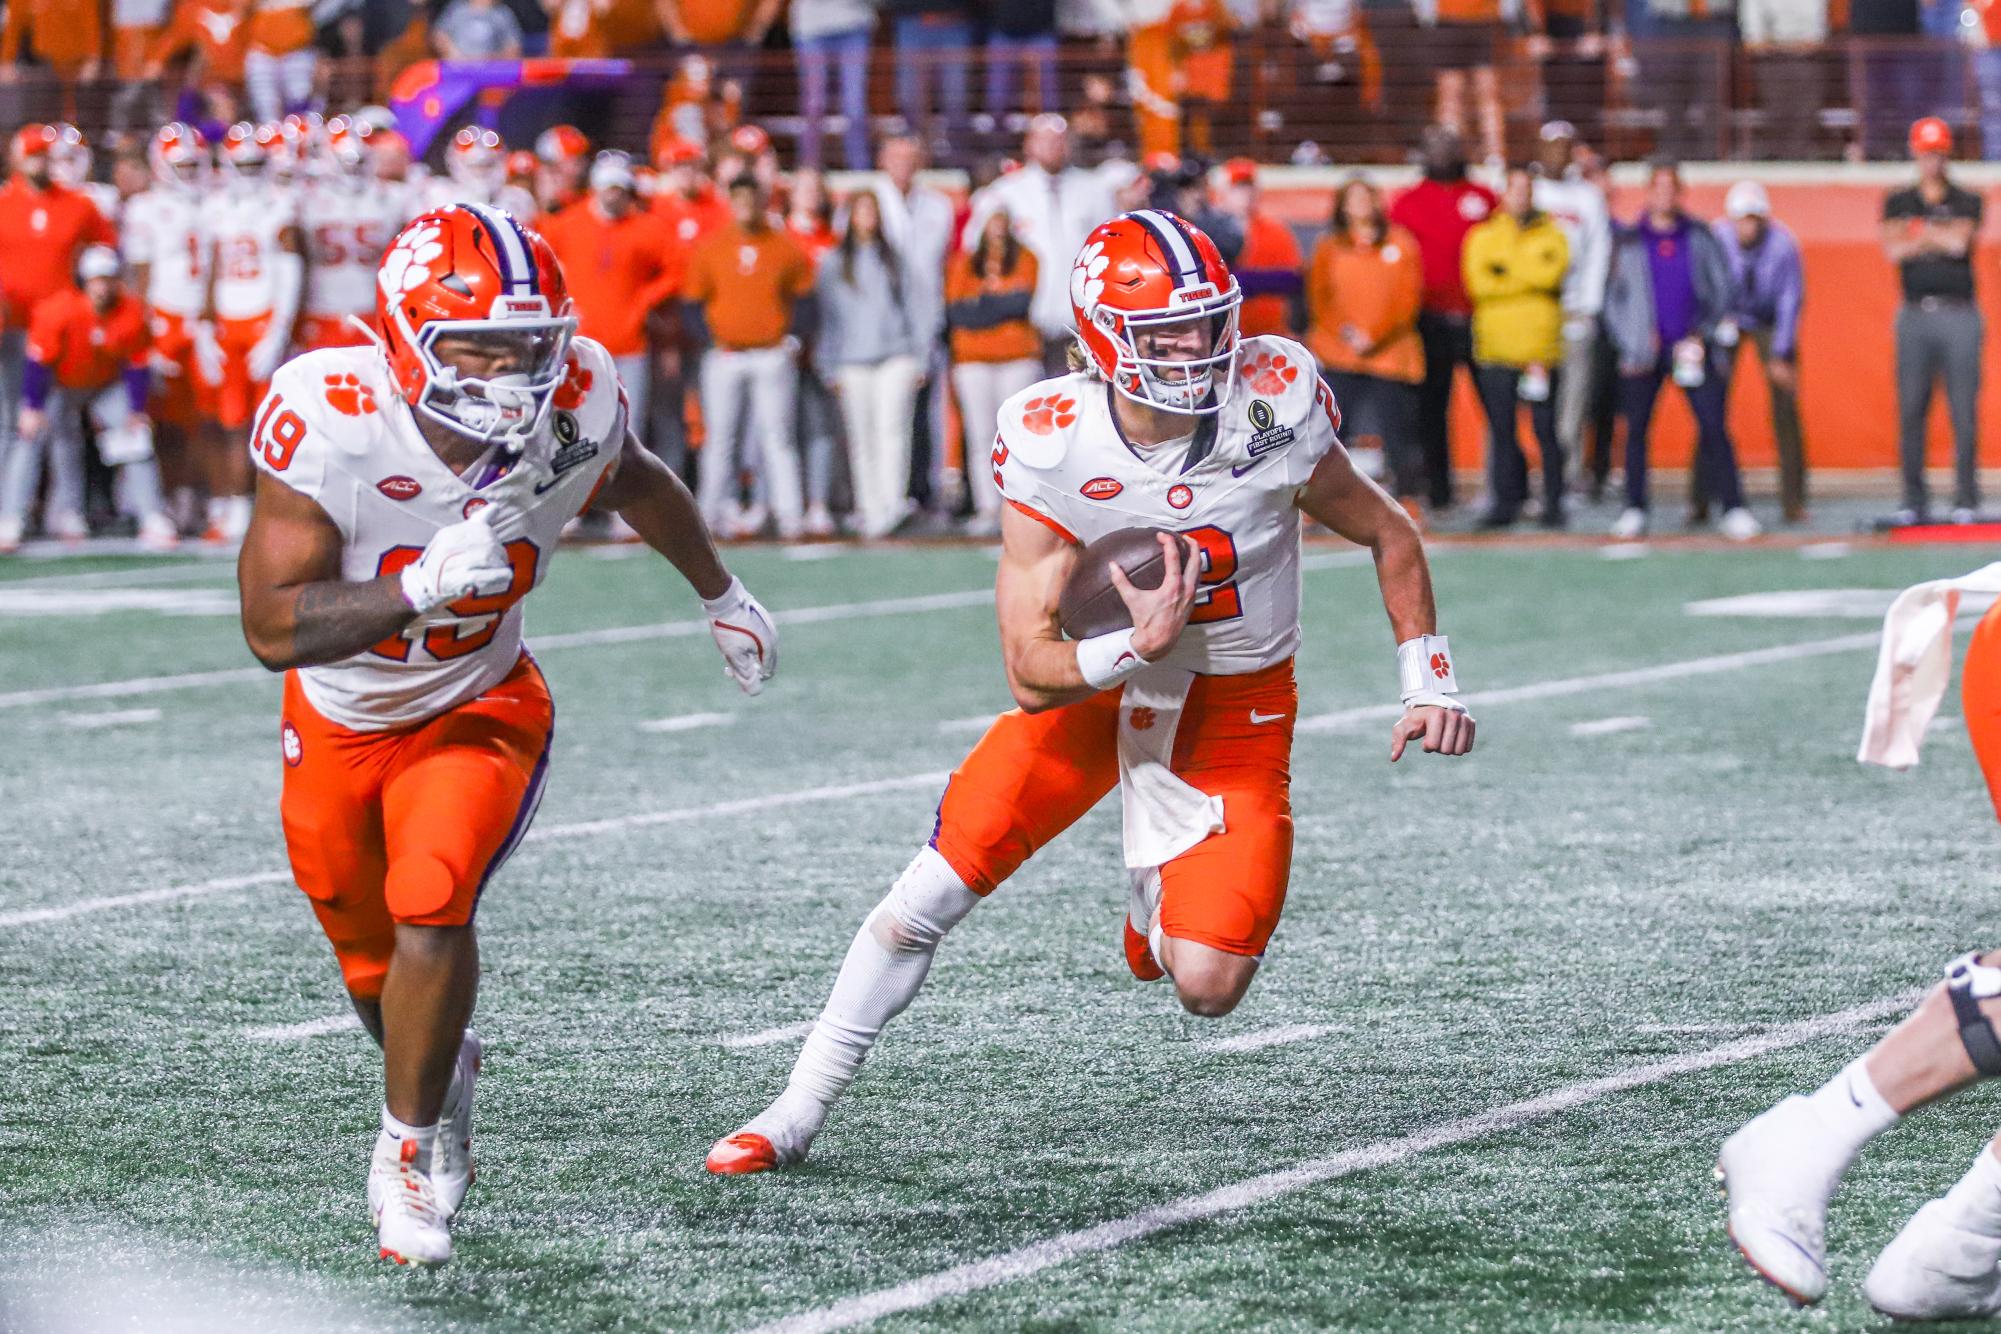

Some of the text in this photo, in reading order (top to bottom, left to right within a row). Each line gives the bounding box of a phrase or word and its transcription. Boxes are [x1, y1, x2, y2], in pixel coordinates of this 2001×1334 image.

[1179, 288, 1213, 302] TIGERS
[254, 393, 307, 471] 19
[1248, 437, 1269, 451] FIRST
[1269, 429, 1292, 443] ROUND
[1253, 426, 1283, 442] PLAYOFF
[381, 480, 417, 492] ACC
[1086, 481, 1117, 493] ACC
[1178, 524, 1244, 625] 2
